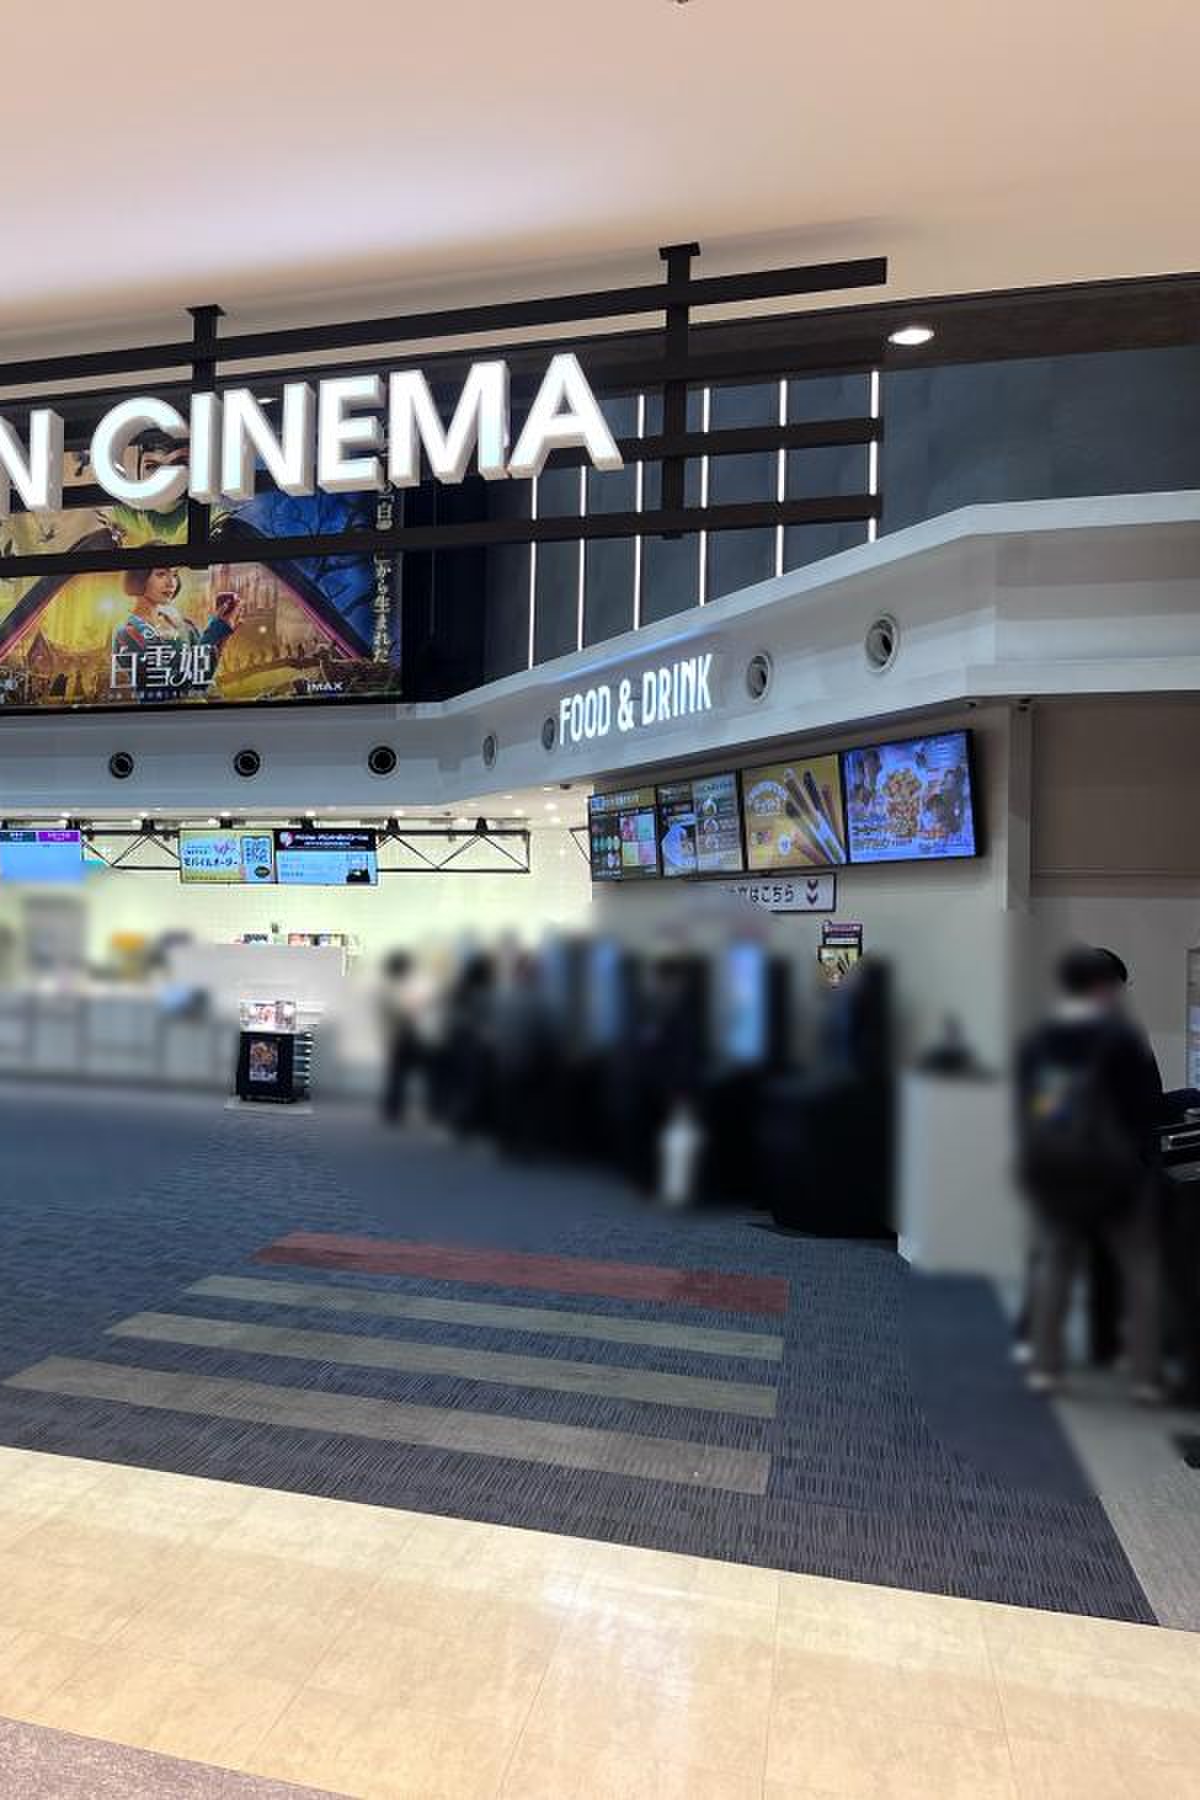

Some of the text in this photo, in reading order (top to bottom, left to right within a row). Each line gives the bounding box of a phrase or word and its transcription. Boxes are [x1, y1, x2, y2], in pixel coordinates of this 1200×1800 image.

[90, 353, 624, 510] CINEMA
[110, 643, 216, 689] 白雪姫
[307, 682, 343, 692] IMAX
[559, 653, 713, 745] FOOD & DRINK
